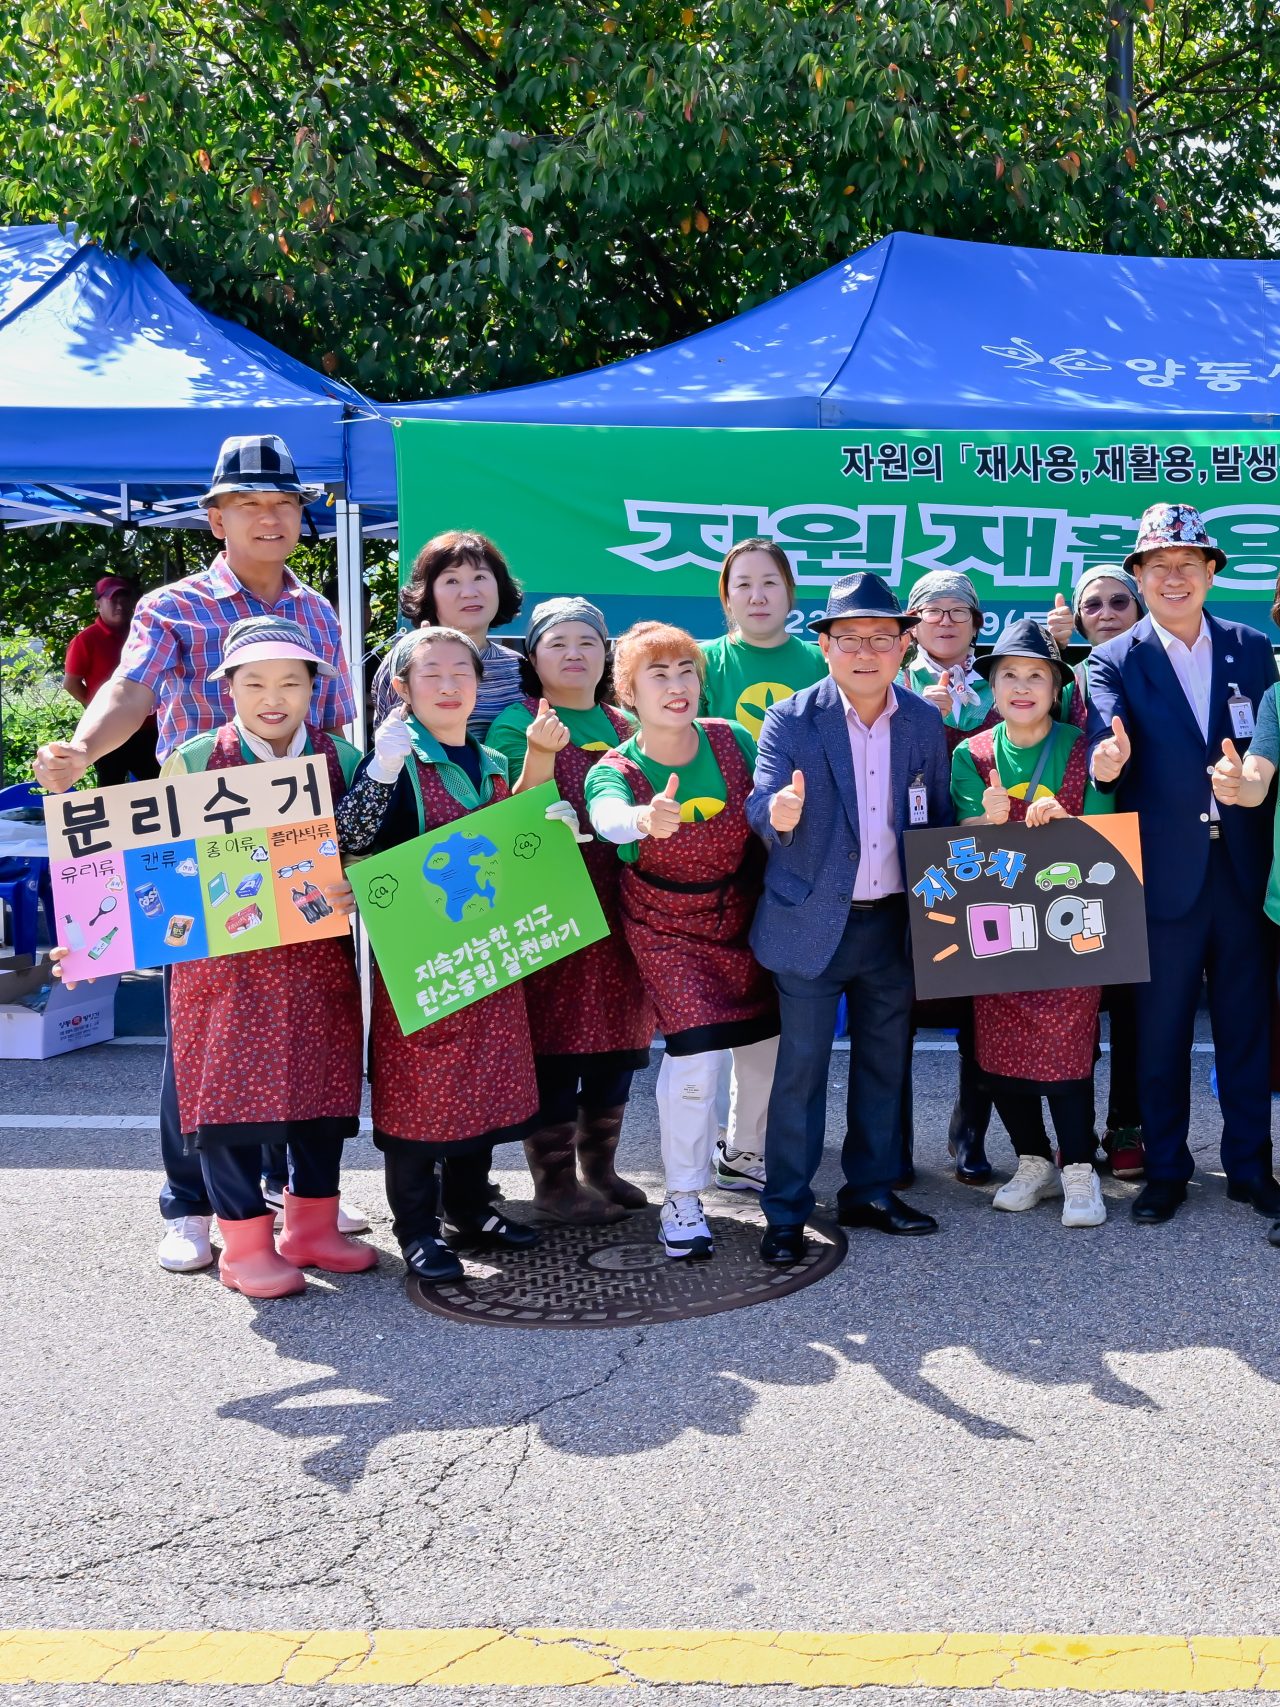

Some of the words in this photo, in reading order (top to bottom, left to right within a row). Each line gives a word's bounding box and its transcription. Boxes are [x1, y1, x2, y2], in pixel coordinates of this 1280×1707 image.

[840, 443, 944, 482] 자원의
[62, 763, 322, 858] 분리수거
[270, 823, 332, 847] 플라스틱류
[60, 859, 115, 884] 유리류
[141, 850, 178, 871] 캔류
[911, 836, 1027, 909] 자동차
[415, 925, 512, 983] 지속가능한
[514, 904, 552, 936] 지구
[967, 896, 1107, 955] 매연
[415, 960, 497, 1017] 탄소중립
[501, 918, 580, 978] 실천하기
